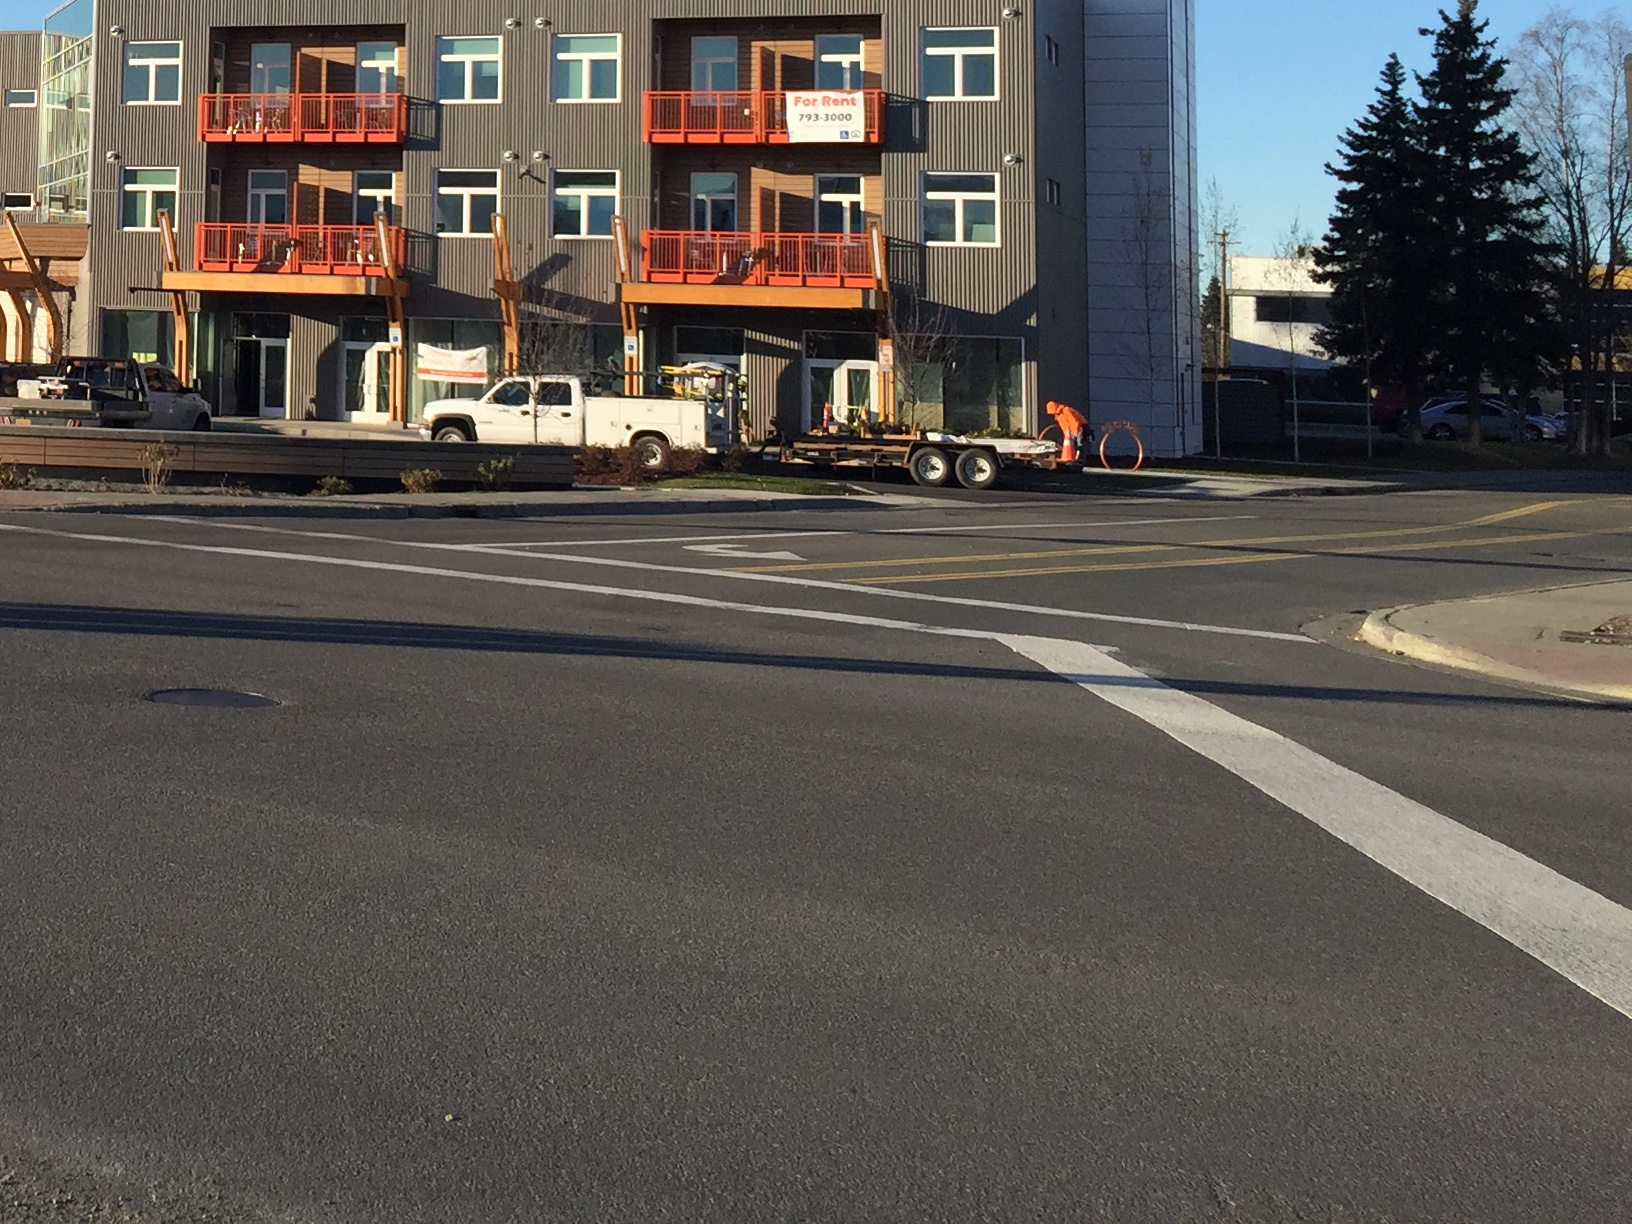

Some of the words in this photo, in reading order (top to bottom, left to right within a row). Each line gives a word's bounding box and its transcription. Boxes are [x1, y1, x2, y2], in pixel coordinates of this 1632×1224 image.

[794, 96, 818, 107] For
[821, 95, 857, 107] Rent
[798, 113, 853, 122] 793-3000
